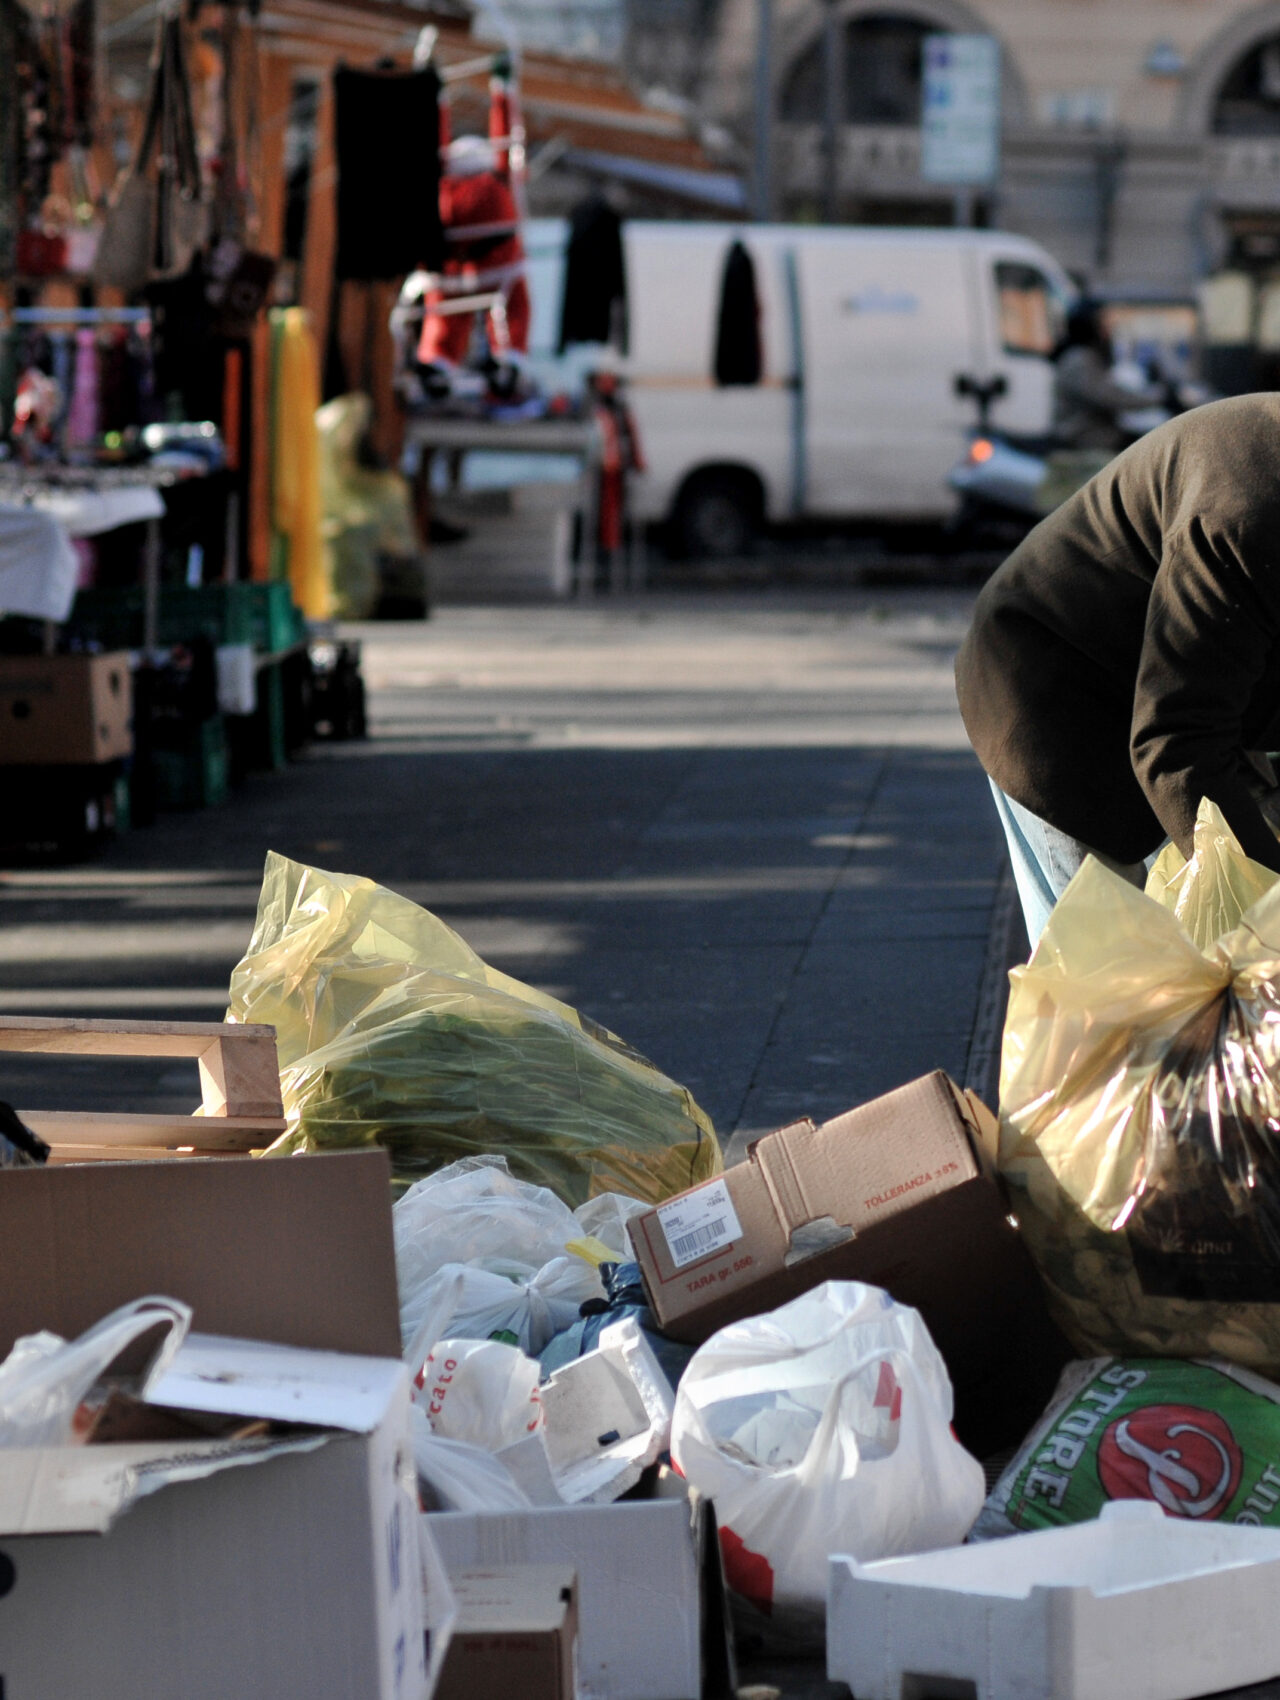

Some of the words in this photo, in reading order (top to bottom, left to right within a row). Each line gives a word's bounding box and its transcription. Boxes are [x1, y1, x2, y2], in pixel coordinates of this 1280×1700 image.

[864, 1172, 932, 1210] TOLLERANZA
[686, 1272, 717, 1294] TARA
[1023, 1364, 1151, 1509] STORE
